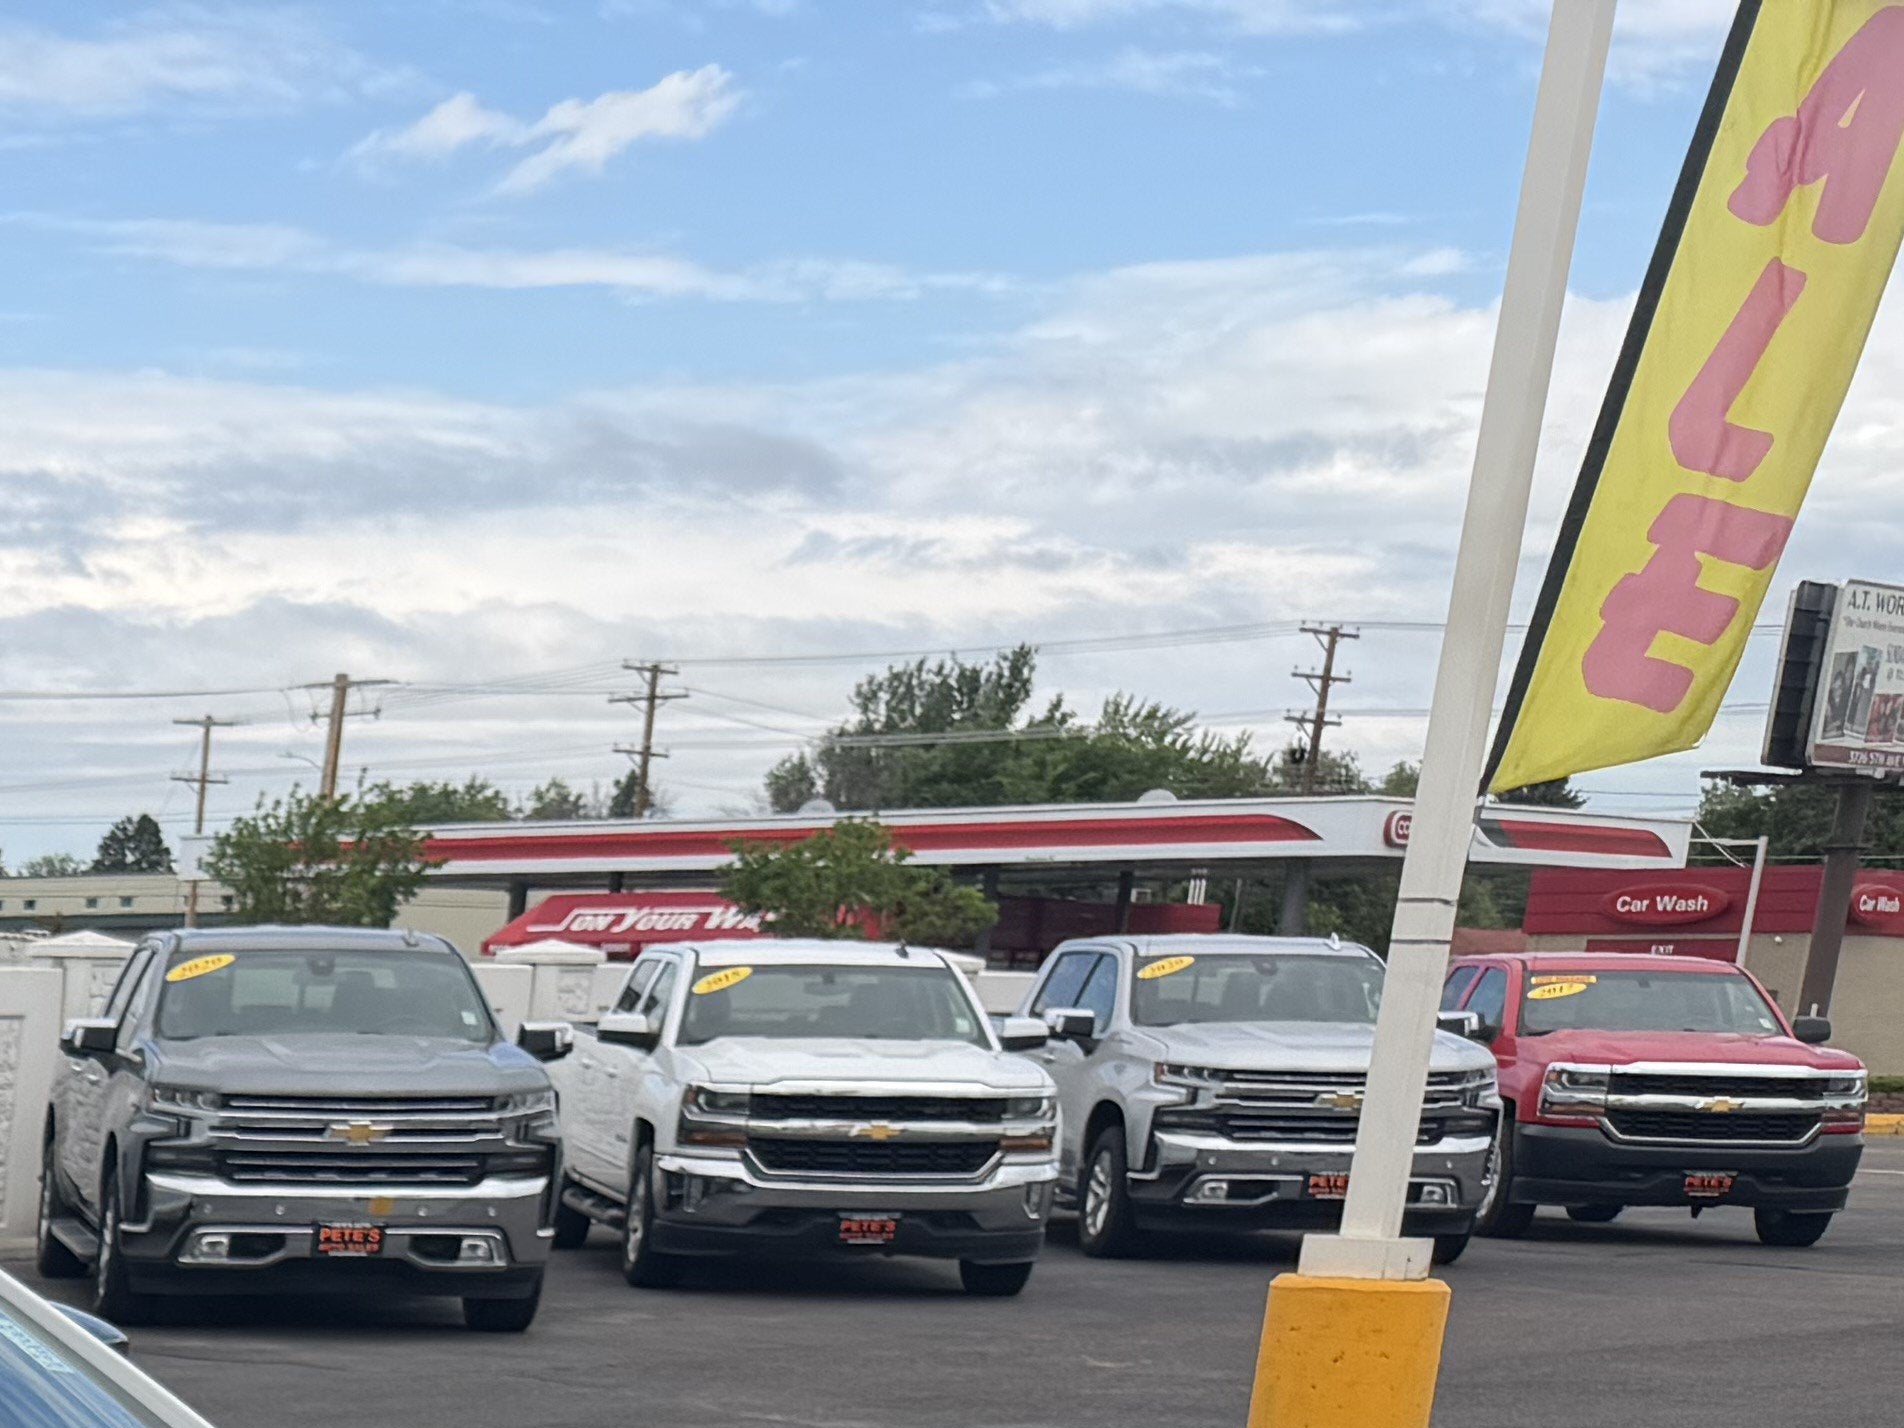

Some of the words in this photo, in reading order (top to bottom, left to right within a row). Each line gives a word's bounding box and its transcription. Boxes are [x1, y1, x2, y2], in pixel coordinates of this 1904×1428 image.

[1616, 895, 1649, 912] Car
[1655, 895, 1709, 912] Wash
[1859, 895, 1876, 911] Car
[1876, 896, 1900, 913] Wash
[319, 1227, 381, 1243] PETE'S
